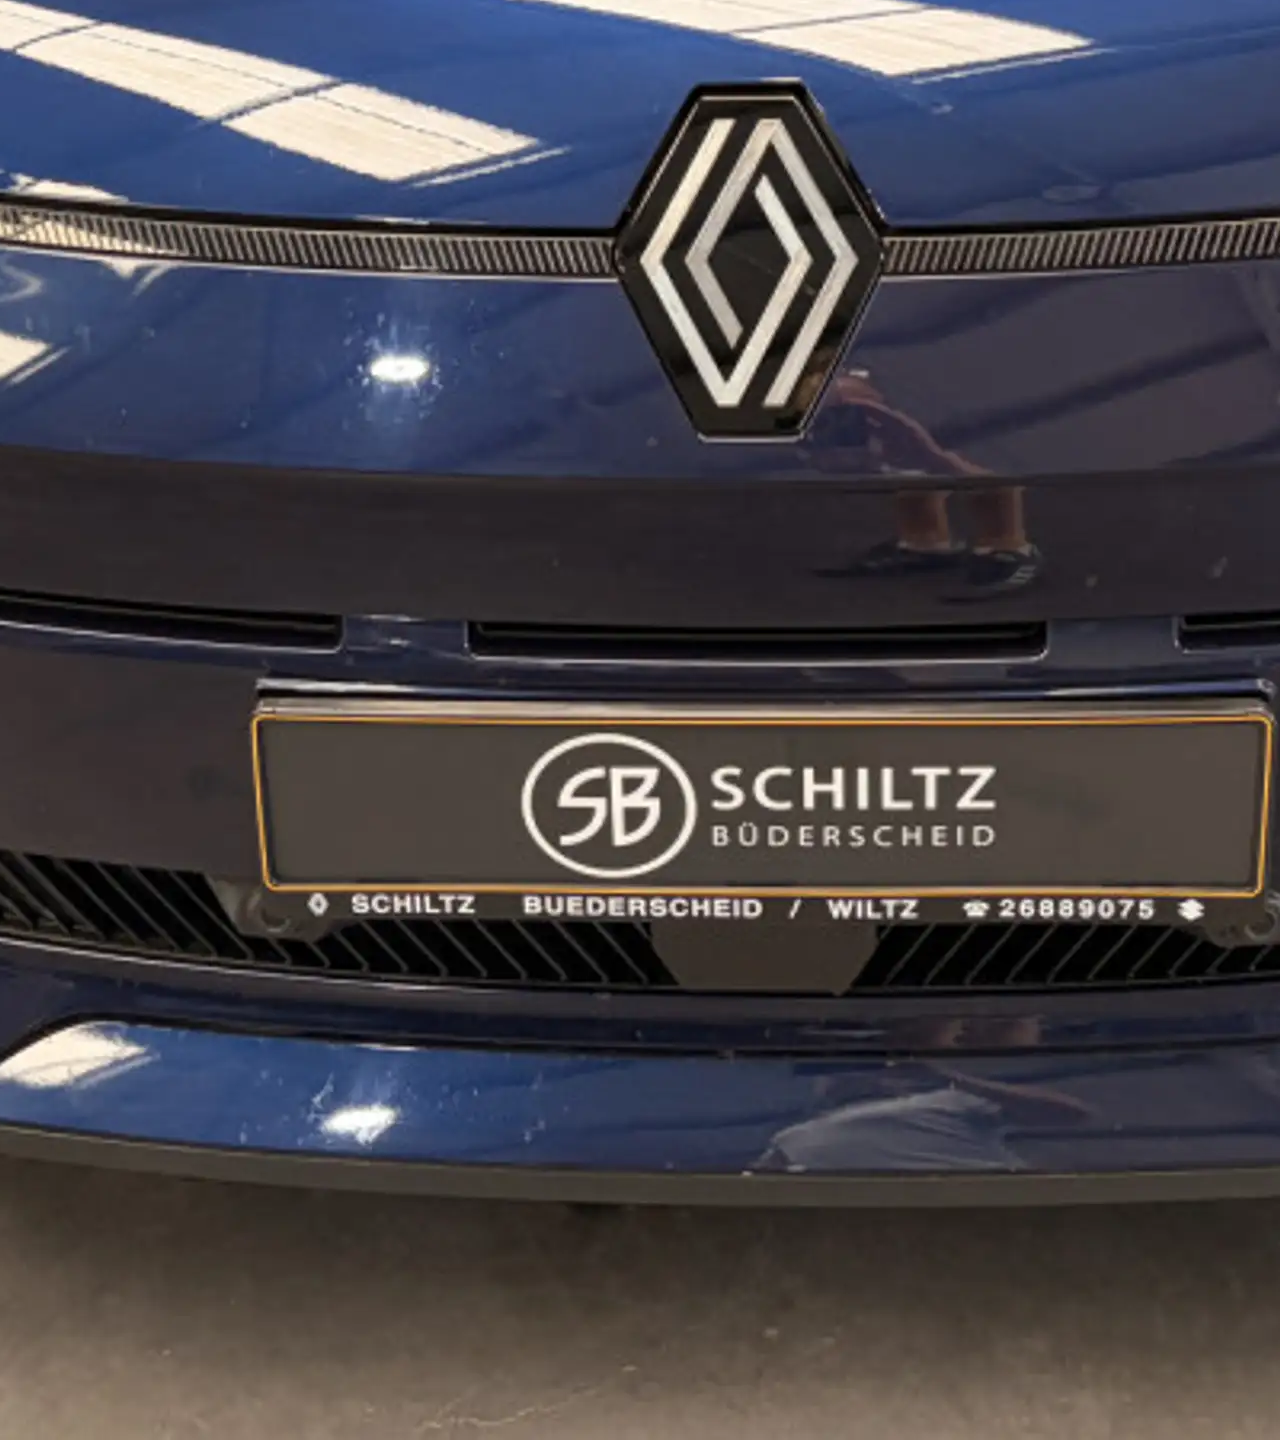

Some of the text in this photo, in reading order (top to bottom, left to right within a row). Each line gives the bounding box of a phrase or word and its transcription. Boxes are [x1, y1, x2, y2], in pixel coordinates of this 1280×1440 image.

[556, 765, 662, 847] SB
[710, 765, 997, 811] SCHILTZ
[711, 822, 996, 848] BÜDERSCHEID
[351, 893, 476, 914] SCHILTZ
[523, 895, 763, 919] BUEDERSCHEID
[827, 899, 919, 920] WILTZ
[998, 898, 1155, 920] 26889075
